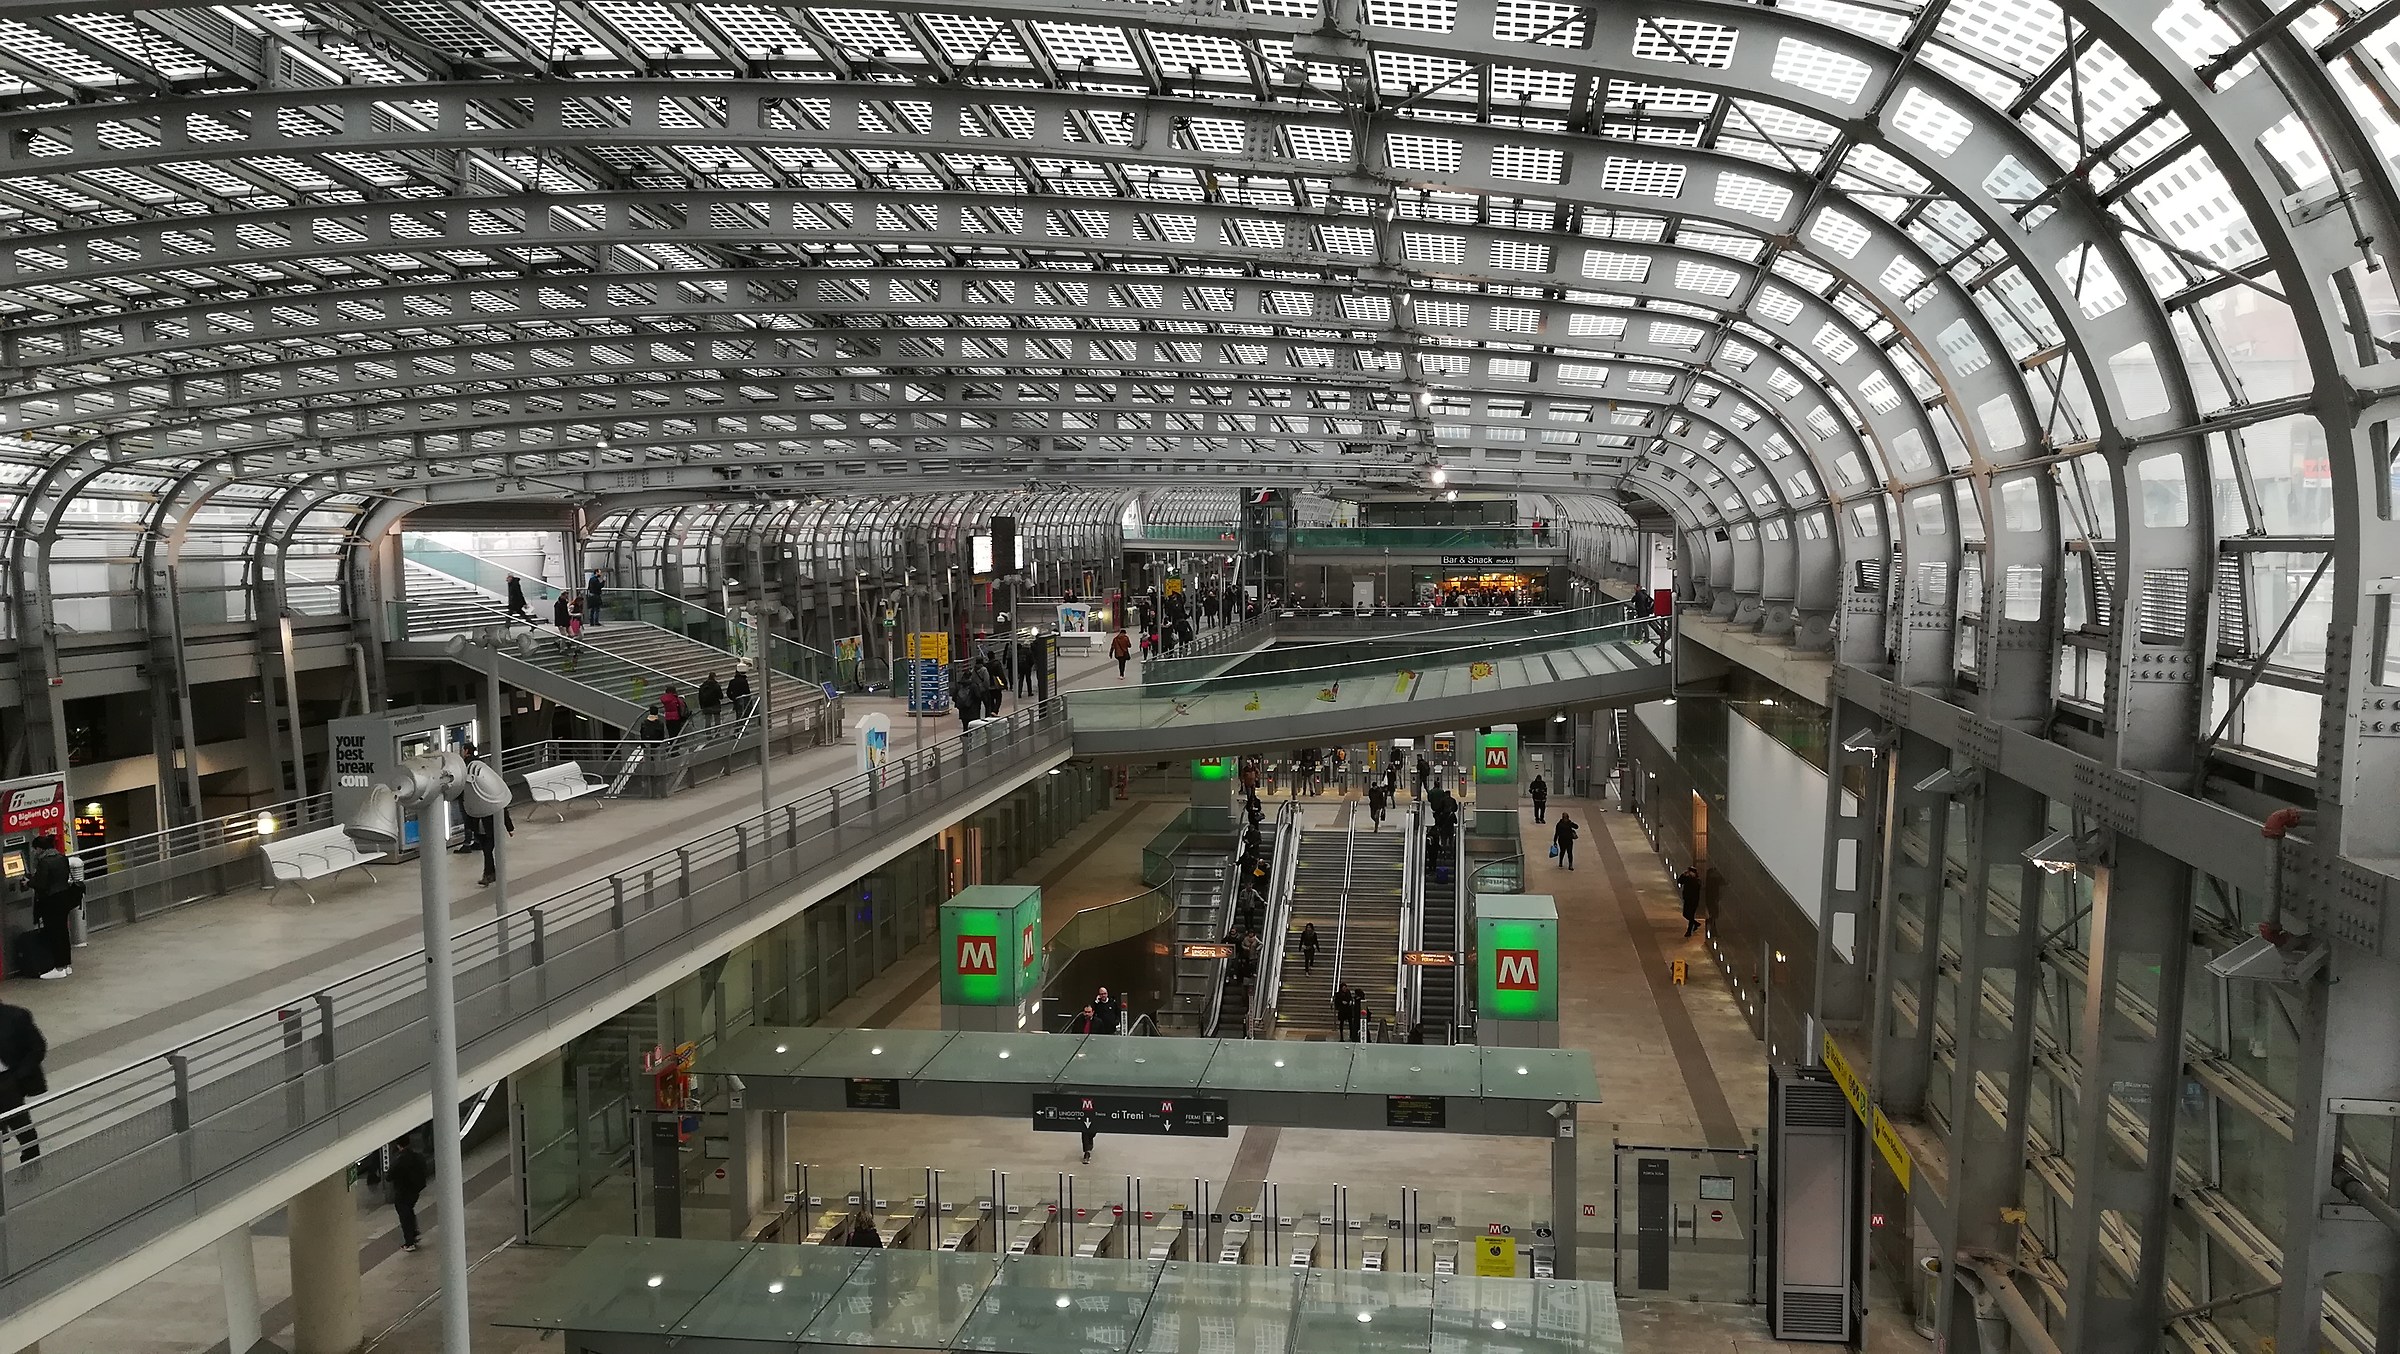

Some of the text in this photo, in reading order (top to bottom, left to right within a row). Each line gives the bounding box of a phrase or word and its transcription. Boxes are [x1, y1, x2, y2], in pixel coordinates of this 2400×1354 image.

[1443, 555, 1457, 564] Bar
[1459, 555, 1466, 564] &
[1467, 555, 1493, 564] Snack
[335, 736, 365, 747] your
[336, 748, 364, 760] best
[1486, 750, 1507, 766] M
[336, 761, 375, 774] break
[338, 775, 368, 787] .com
[1024, 930, 1034, 962] M
[960, 942, 995, 969] M
[1498, 956, 1537, 984] M
[1082, 1100, 1093, 1109] M
[1162, 1102, 1173, 1111] M
[1111, 1110, 1144, 1120] ai Treni
[1584, 1206, 1595, 1215] M
[1872, 1216, 1884, 1225] M
[1489, 1225, 1501, 1234] M
